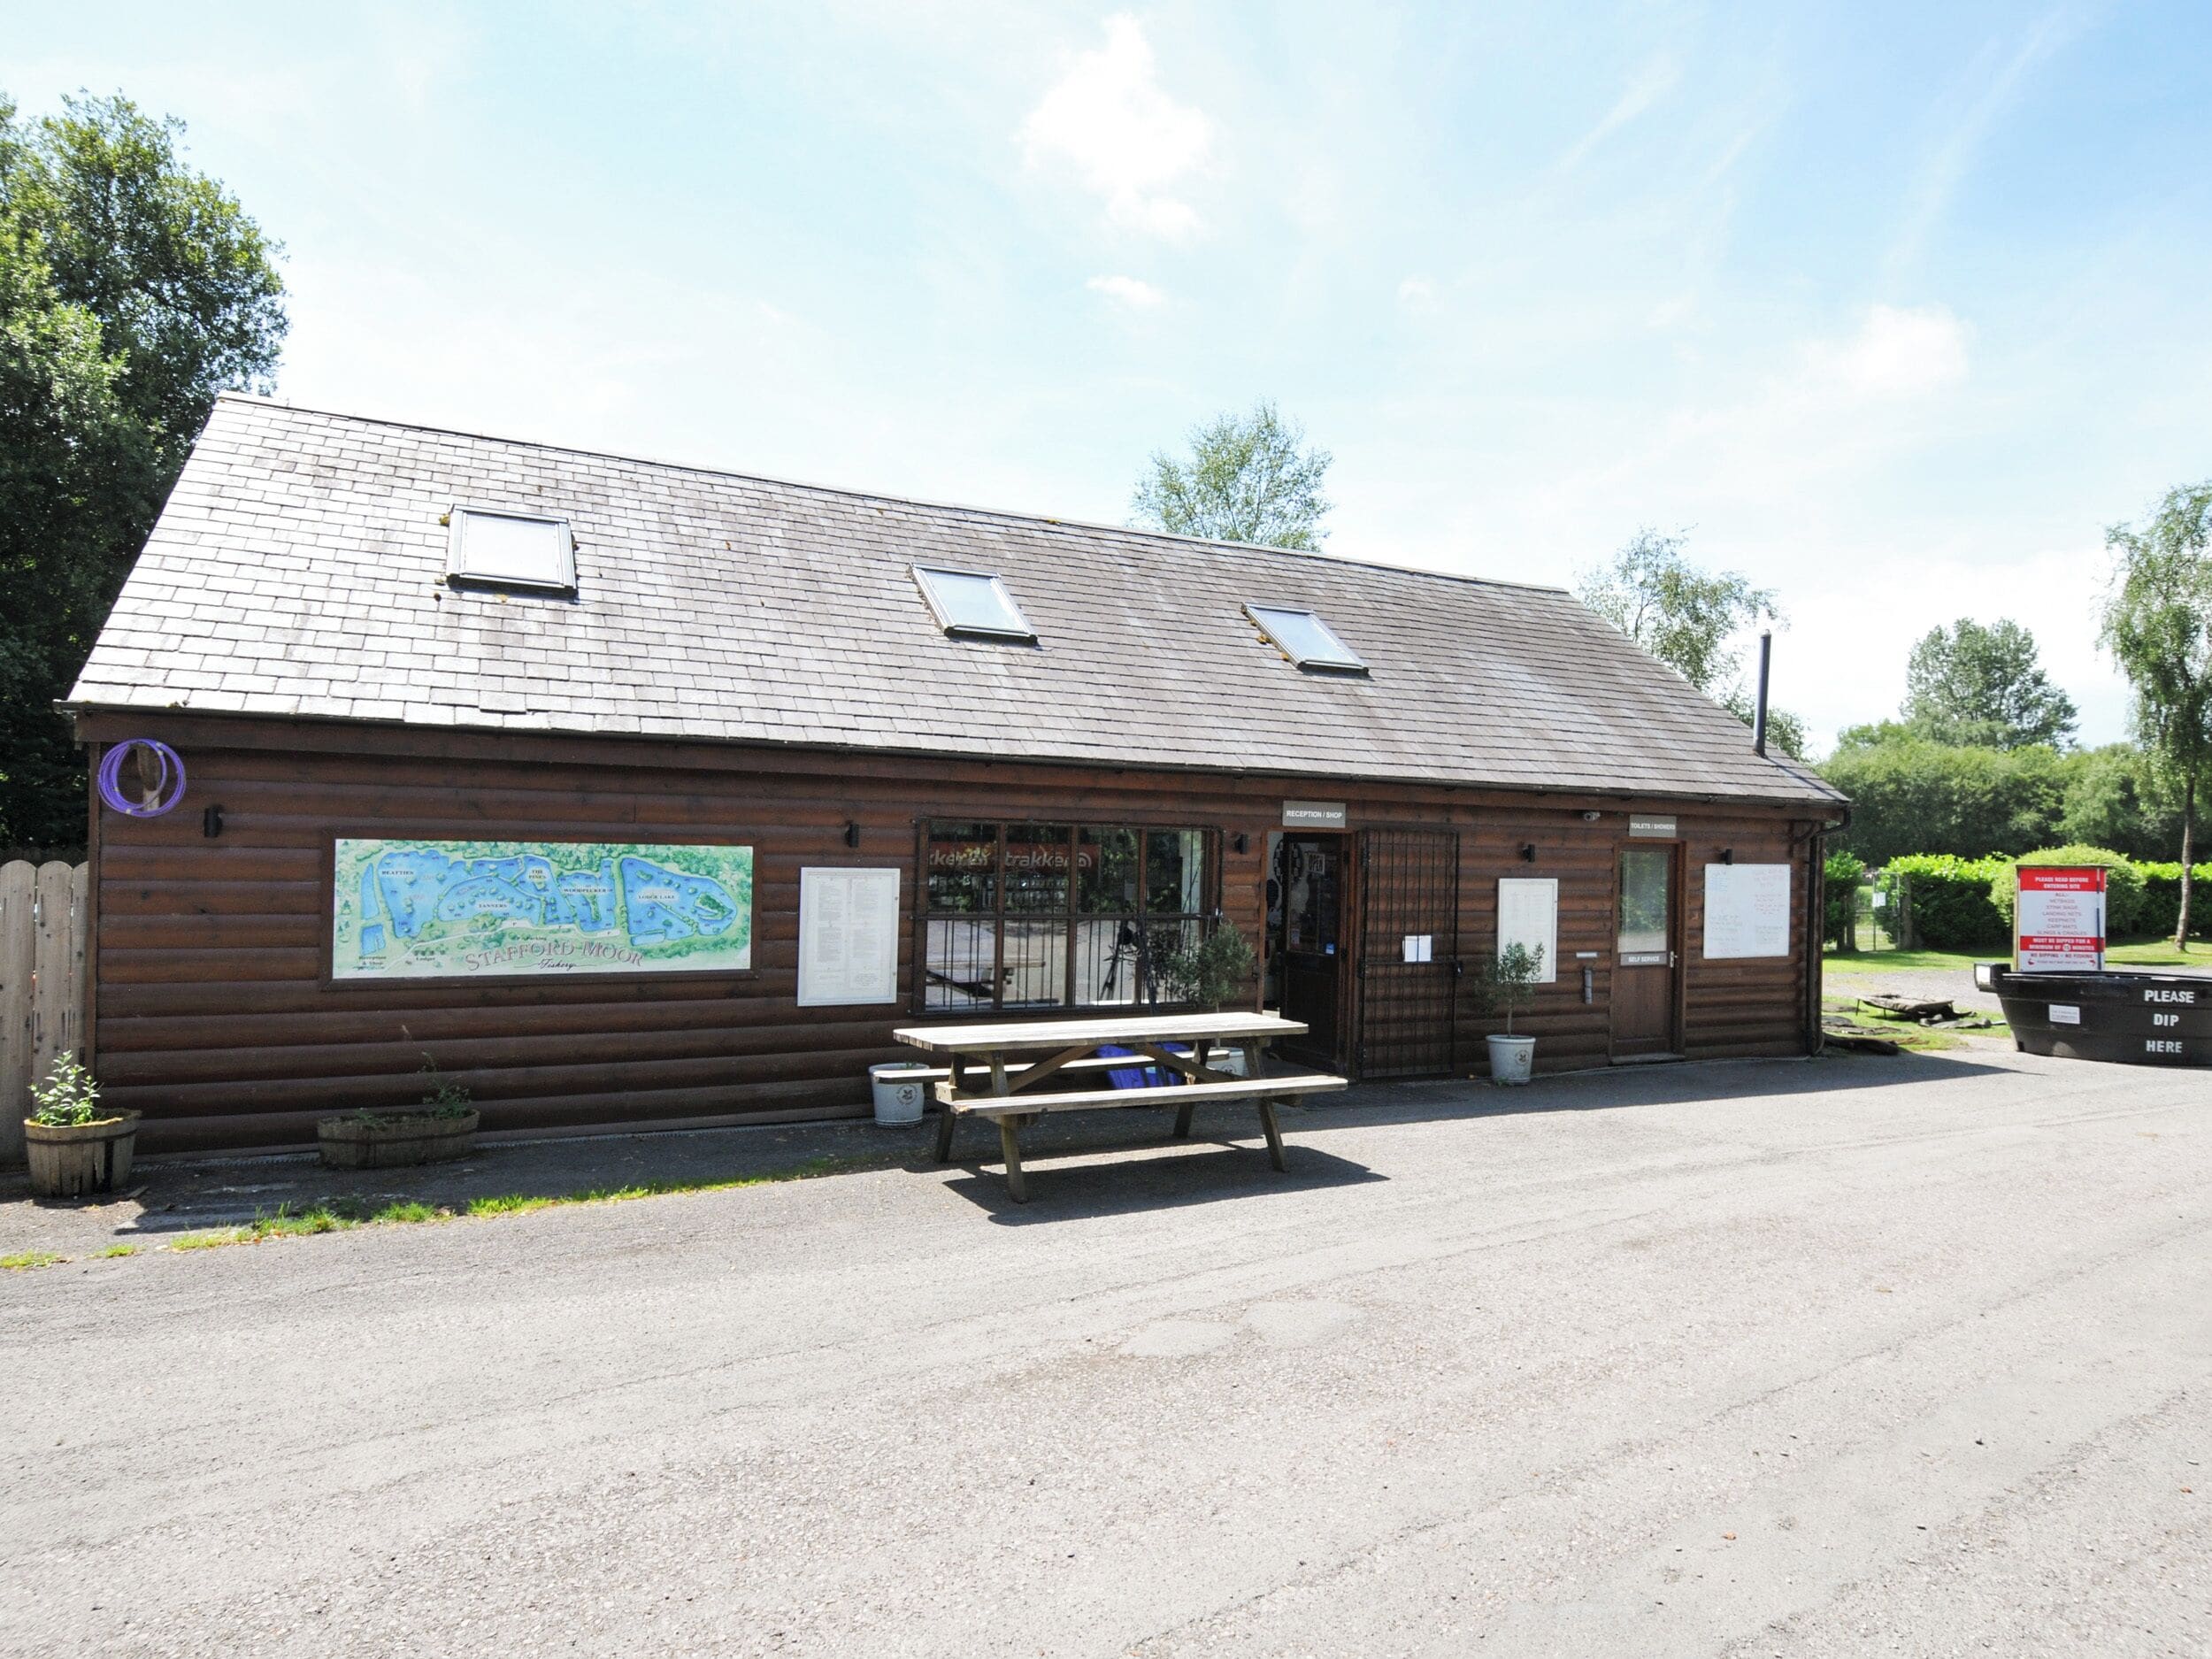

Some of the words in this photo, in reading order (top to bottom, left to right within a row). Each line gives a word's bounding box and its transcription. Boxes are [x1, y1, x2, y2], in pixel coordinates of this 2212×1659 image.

[1286, 810, 1322, 818] RECEPTION
[465, 941, 575, 972] STAFFORD
[581, 941, 644, 966] MOOR
[538, 958, 575, 972] Fishery
[2144, 989, 2194, 1003] PLEASE
[2153, 1013, 2179, 1026] DIP
[2146, 1040, 2183, 1054] HERE
